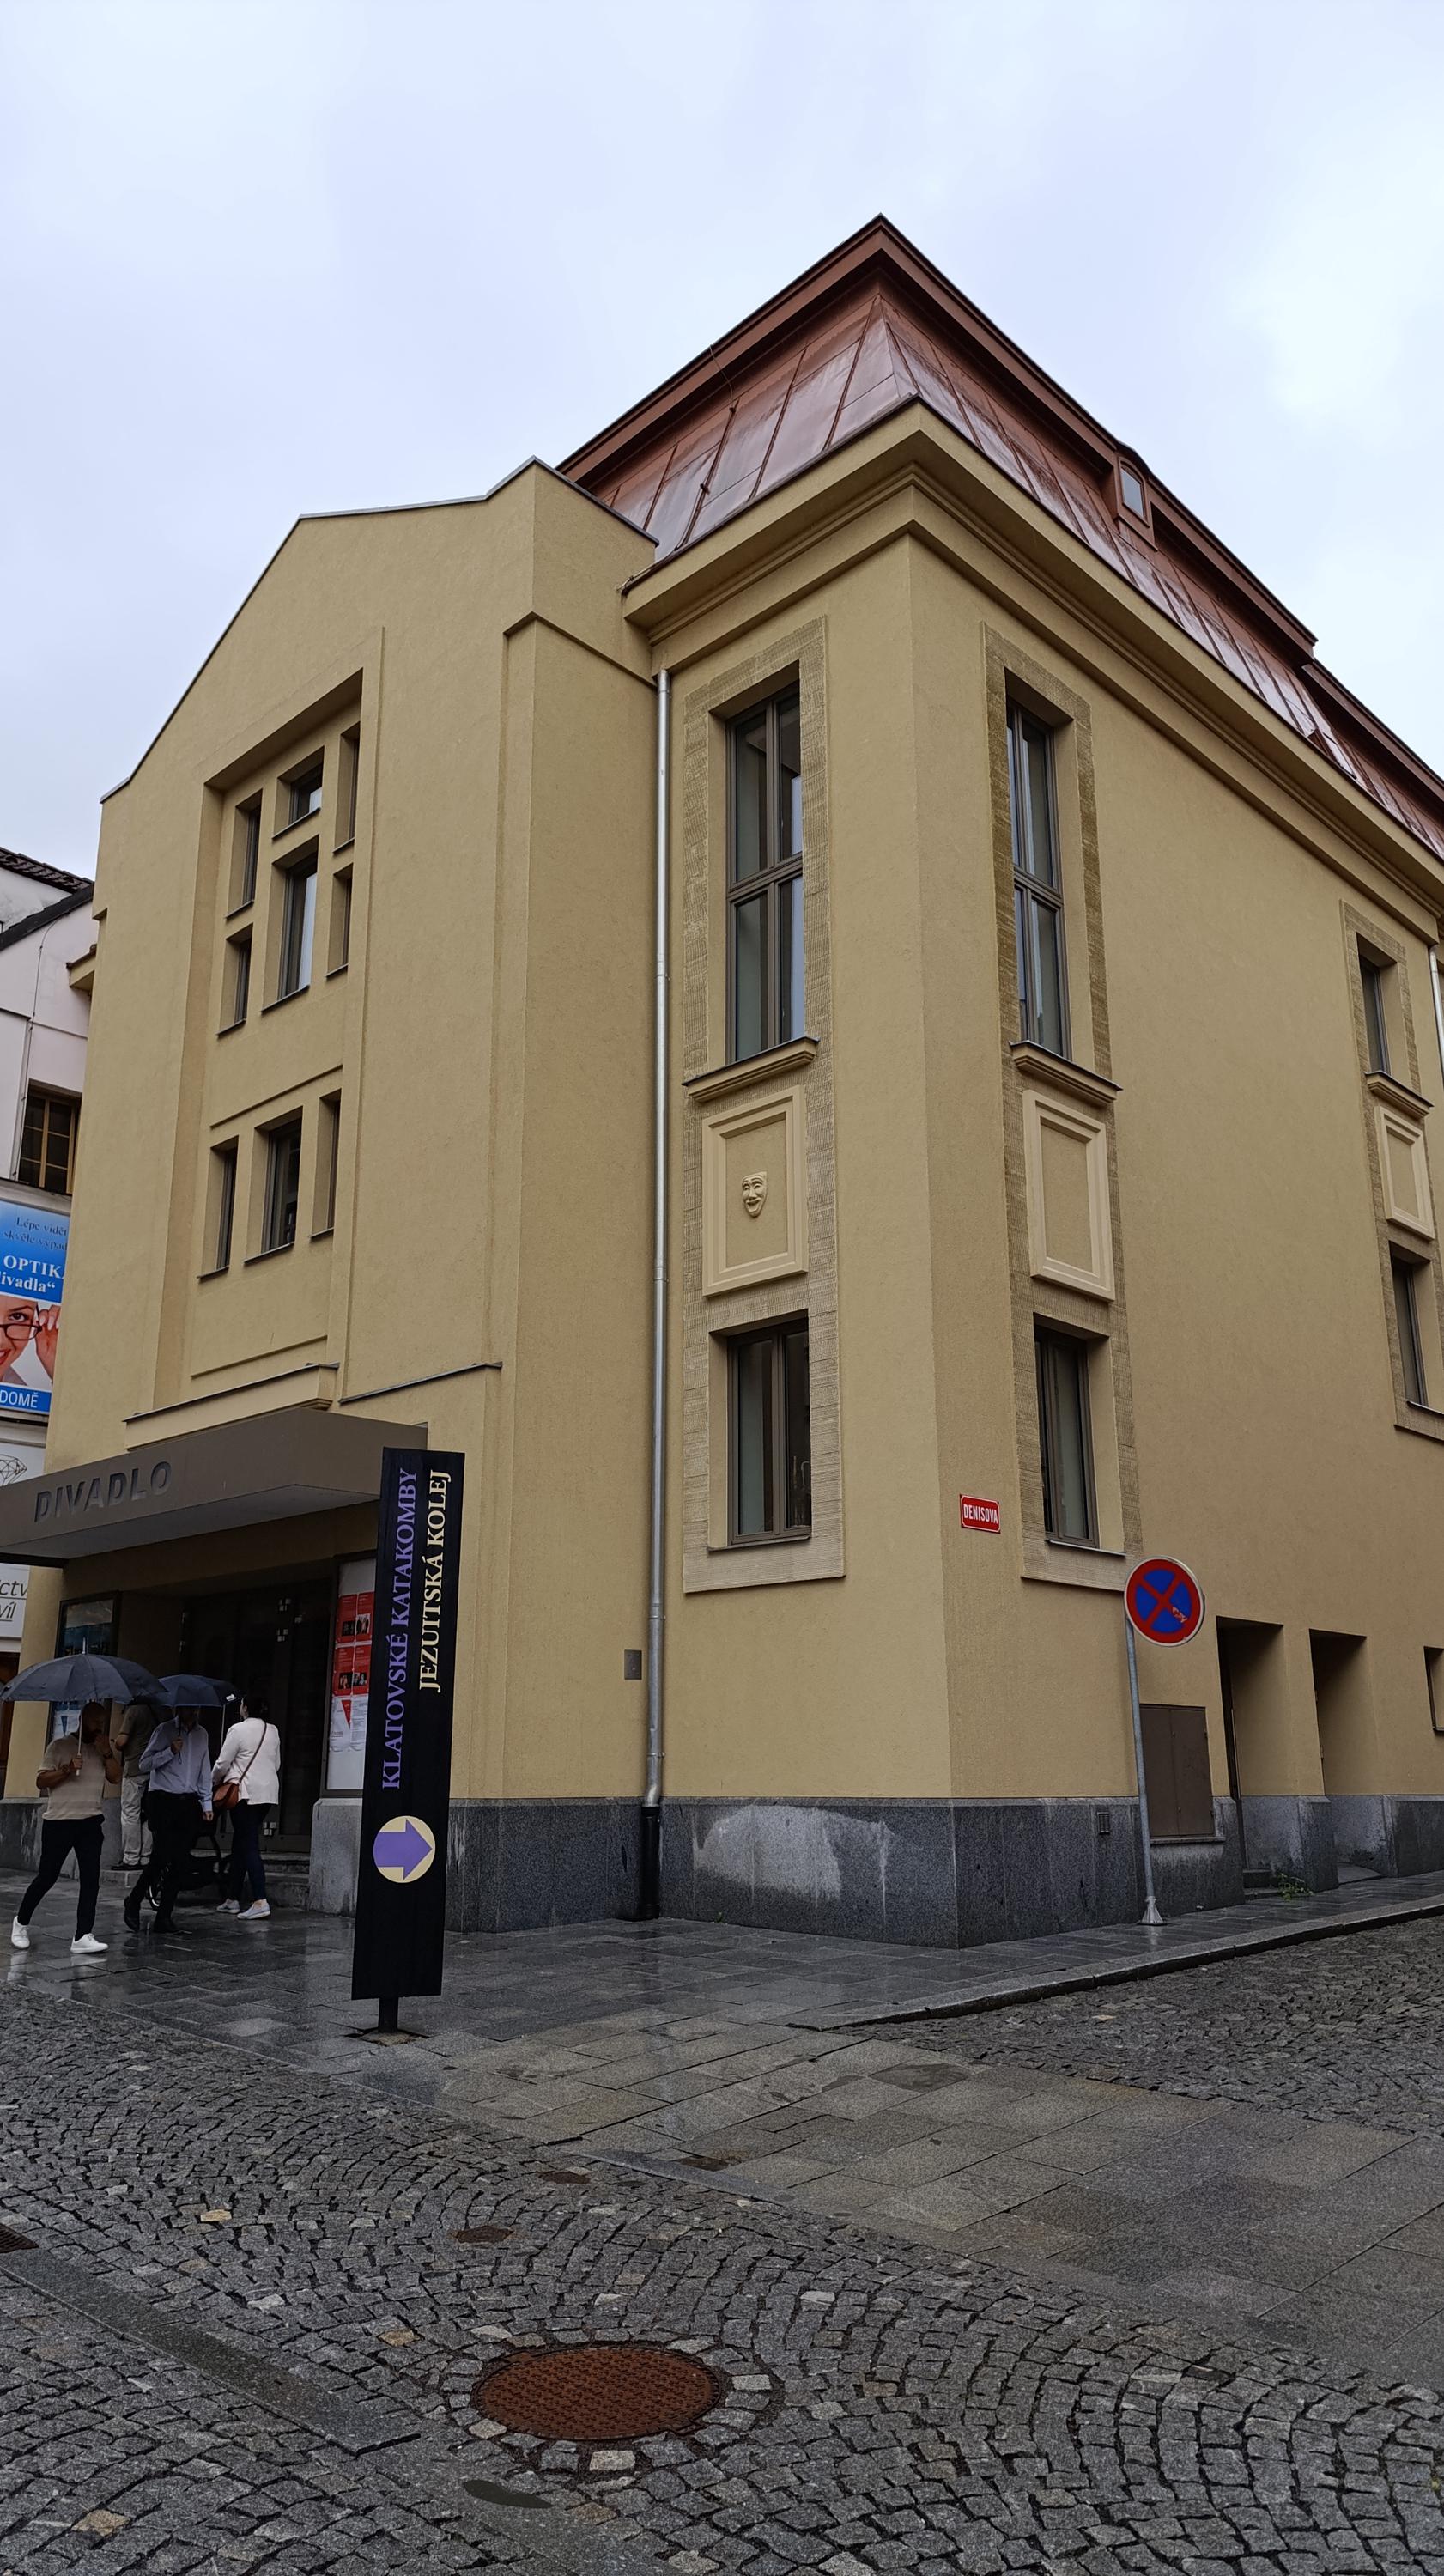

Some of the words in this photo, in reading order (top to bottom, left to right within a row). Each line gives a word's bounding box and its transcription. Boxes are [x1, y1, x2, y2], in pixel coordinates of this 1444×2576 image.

[16, 1216, 40, 1230] Lépe
[0, 1271, 56, 1293] ivadla“
[3, 1255, 64, 1279] OPTIK
[0, 1389, 39, 1408] DOMĚ
[33, 1461, 172, 1523] DIVADLO
[427, 1469, 452, 1546] KOLEJ
[963, 1504, 998, 1524] DENISOVA
[391, 1467, 417, 1627] KATAKOMBY
[419, 1552, 444, 1693] JEZUITSKÁ
[382, 1633, 409, 1789] KLATOVSKÉ
